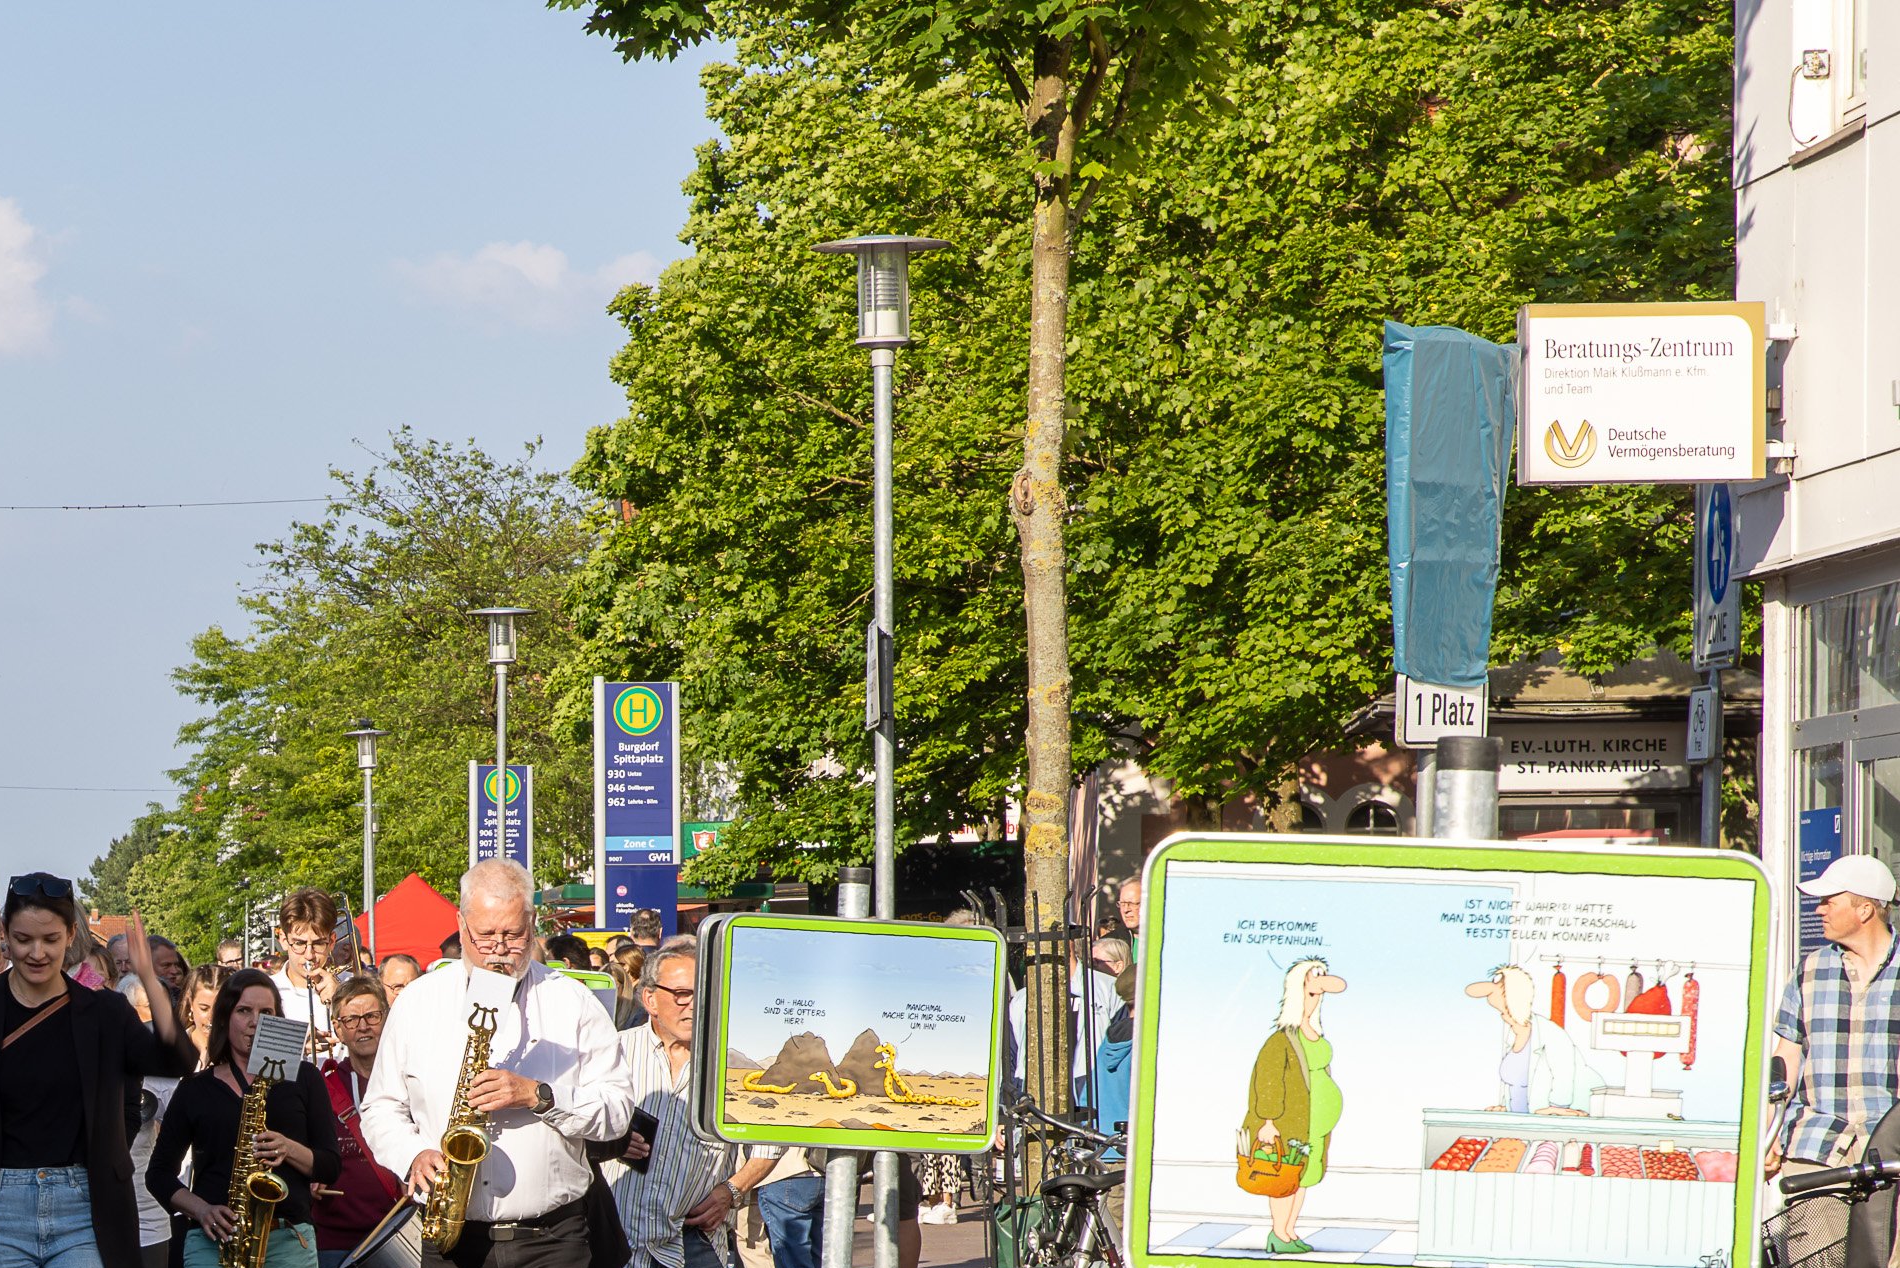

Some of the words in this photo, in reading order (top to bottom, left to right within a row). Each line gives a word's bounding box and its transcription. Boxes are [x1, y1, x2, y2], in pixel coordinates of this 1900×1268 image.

[1545, 337, 1734, 363] Beratungs-Zentrum
[1544, 367, 1590, 379] Direktion
[1593, 366, 1618, 379] Maik
[1621, 366, 1672, 378] Klußmann
[1675, 368, 1683, 377] e.
[1686, 366, 1709, 377] Kfm.
[1544, 383, 1563, 395] und
[1566, 383, 1593, 395] Team
[1608, 427, 1667, 441] Deutsche
[1608, 443, 1735, 461] Vermögensberatung
[1708, 612, 1727, 644] ZONE
[1416, 693, 1423, 726] 1
[1432, 693, 1475, 726] Platz
[618, 742, 660, 754] Burgdorf
[1510, 739, 1596, 753] EV.-LUTH.
[1603, 738, 1667, 753] KIRCHE
[613, 754, 664, 766] Spittaplatz
[1517, 761, 1540, 774] ST.
[1547, 759, 1661, 773] PANKRATIUS
[607, 769, 626, 779] 930
[607, 783, 626, 793] 946
[607, 797, 626, 807] 962
[479, 829, 493, 837] 906
[479, 840, 492, 848] 907
[623, 839, 647, 848] Zone
[648, 839, 655, 848] C
[479, 850, 493, 858] 910
[648, 853, 671, 862] GVH
[1465, 899, 1483, 910] IST
[1488, 900, 1521, 911] NICHT
[1237, 919, 1255, 930] ICH
[1260, 920, 1318, 932] BEKOMME
[1440, 912, 1465, 923] MAN
[1468, 913, 1492, 924] DAS
[1495, 914, 1529, 925] NICHT
[1533, 915, 1554, 926] MIT
[1559, 916, 1637, 929] ULTRASCHALL
[1223, 933, 1242, 943] EIN
[1465, 927, 1548, 941] FESTSTELLEN
[775, 998, 785, 1006] OH
[906, 1003, 942, 1012] MANCHMAL
[763, 1006, 781, 1015] SIND
[783, 1007, 794, 1015] SIE
[882, 1011, 905, 1019] MACHE
[907, 1012, 919, 1020] ICH
[920, 1013, 934, 1021] MIR
[935, 1014, 966, 1022] SORGEN
[910, 1022, 921, 1030] UM
